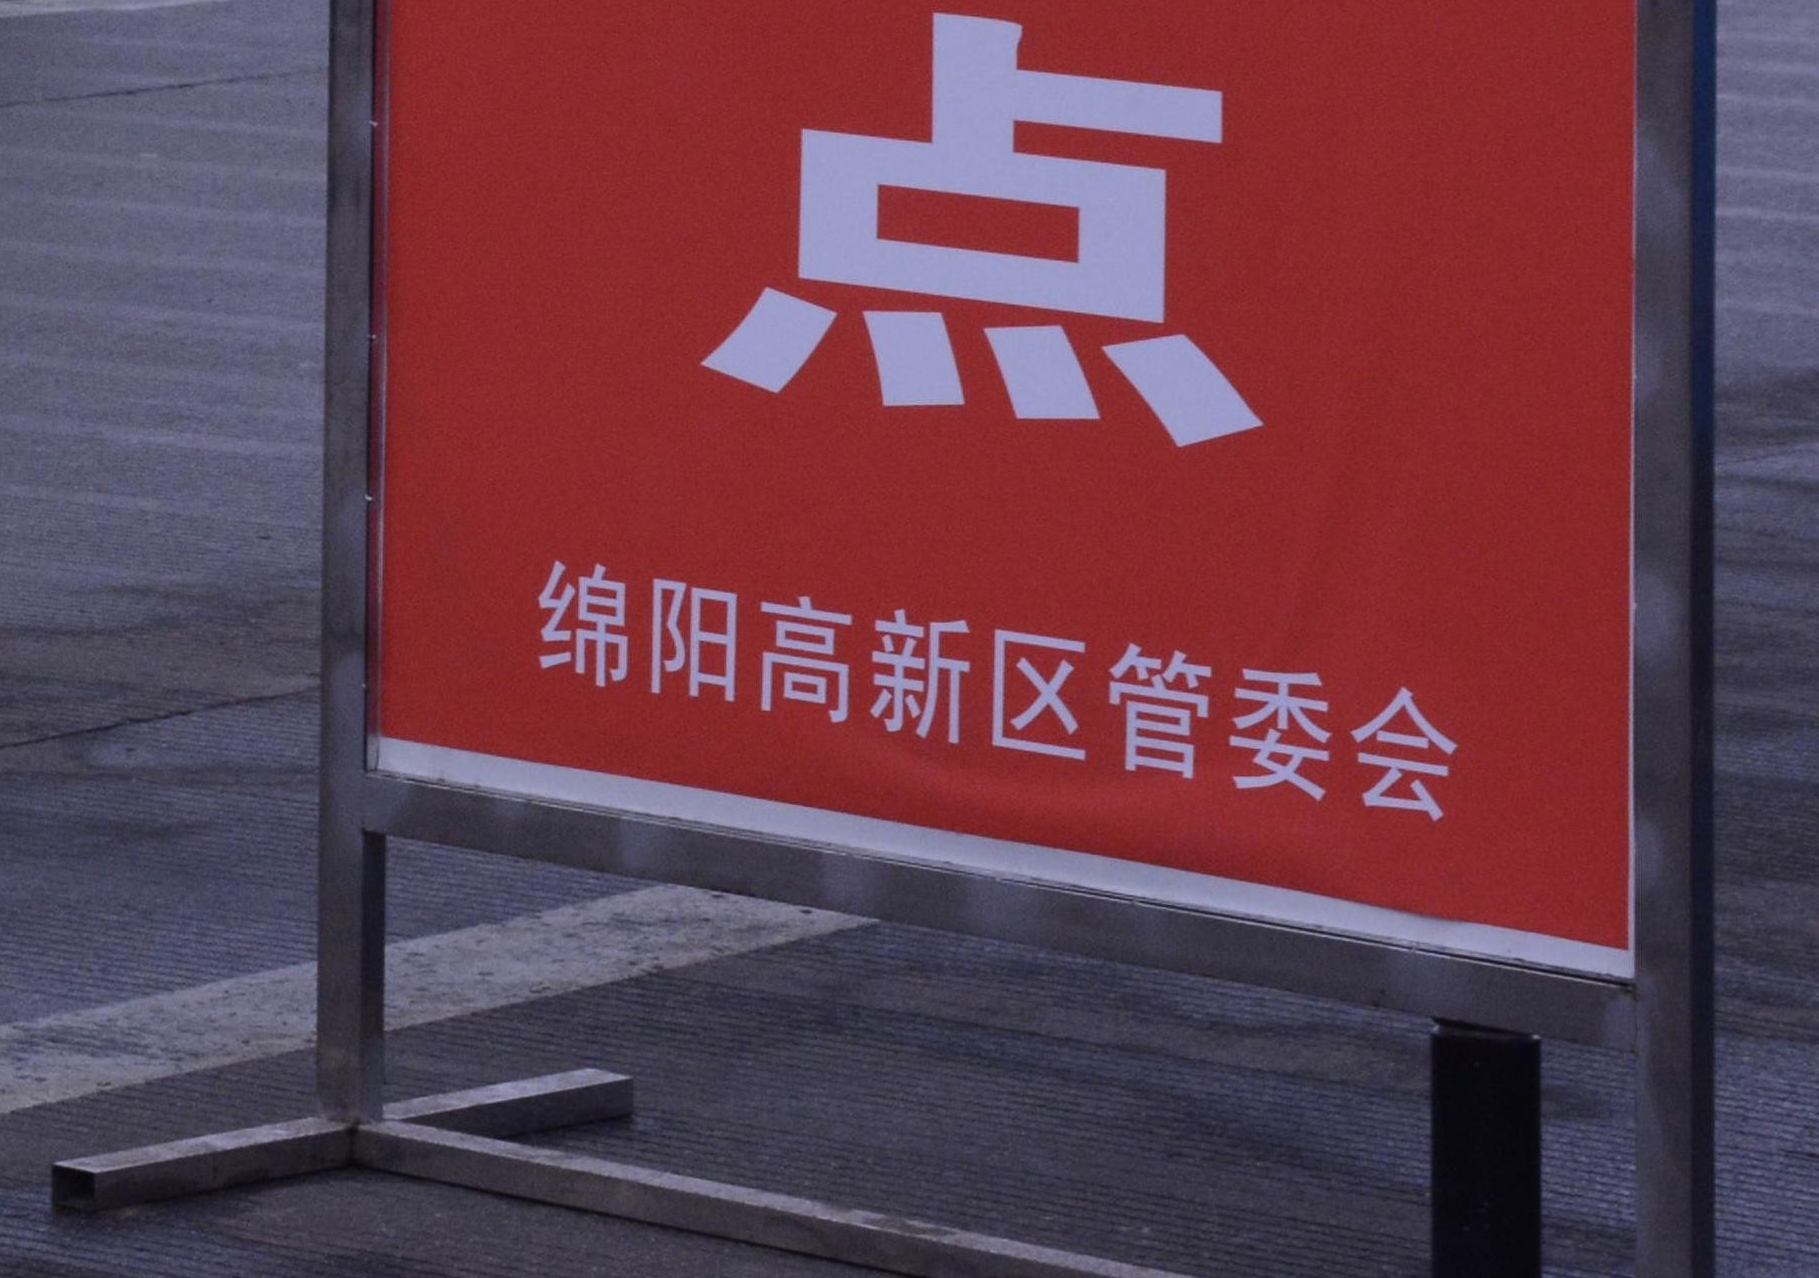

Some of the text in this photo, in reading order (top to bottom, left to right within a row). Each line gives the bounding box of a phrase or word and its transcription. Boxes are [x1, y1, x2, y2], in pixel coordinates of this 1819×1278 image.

[537, 560, 1458, 822] 绵阳高新区管委会
